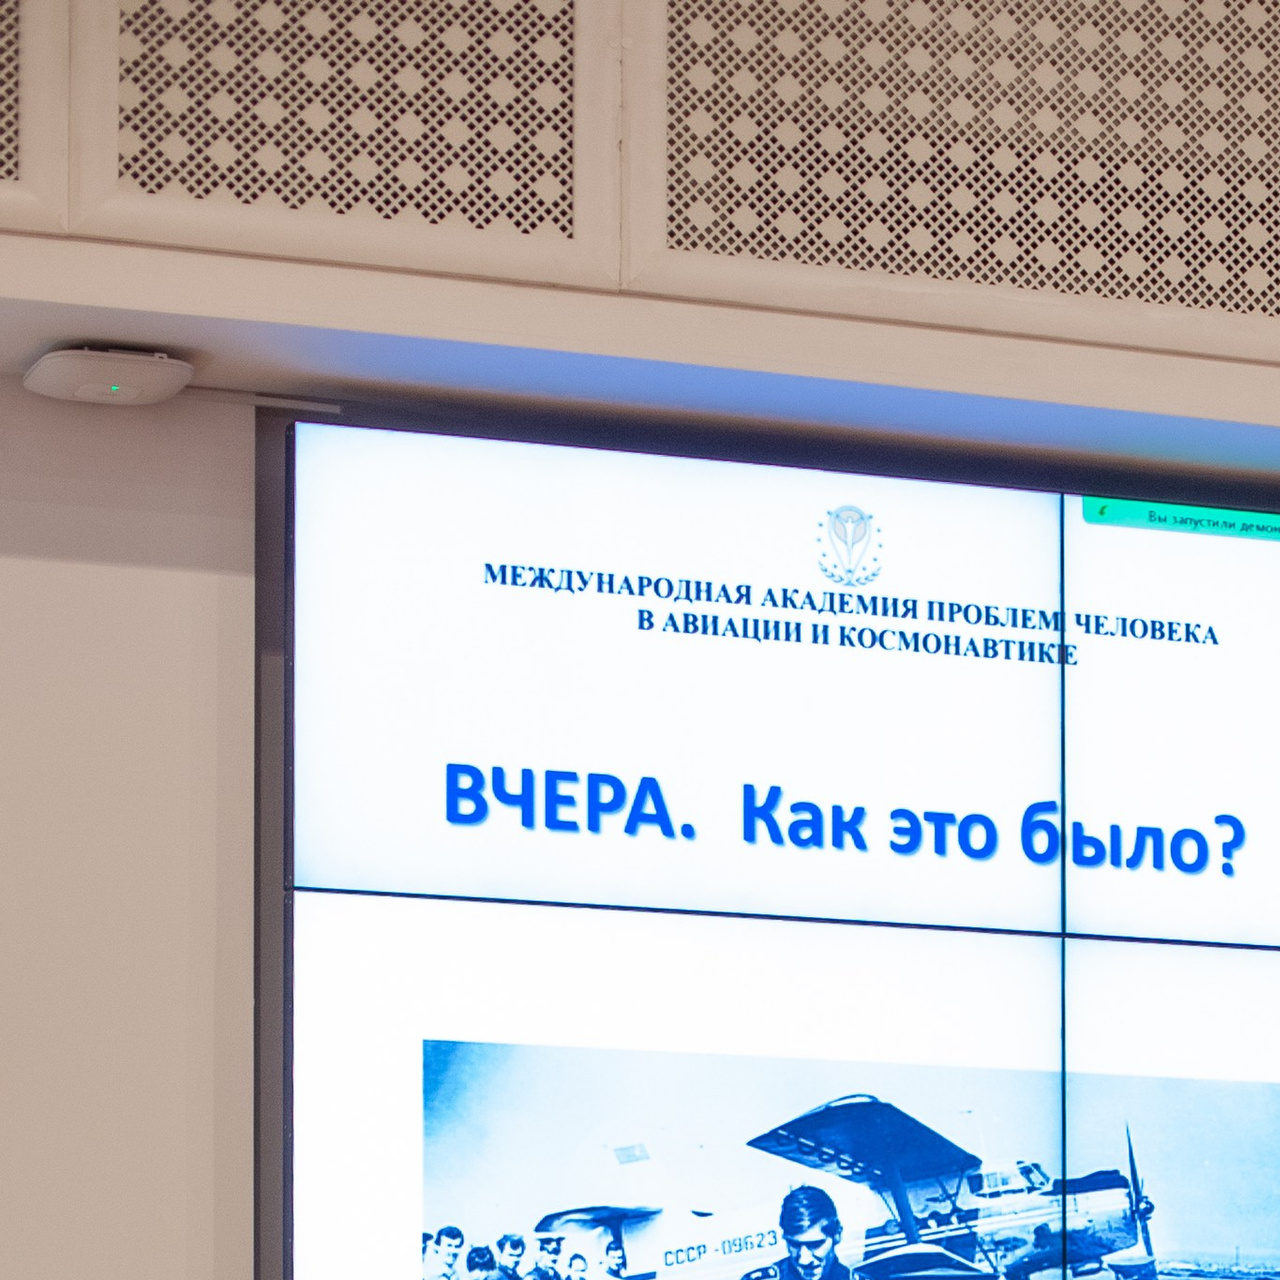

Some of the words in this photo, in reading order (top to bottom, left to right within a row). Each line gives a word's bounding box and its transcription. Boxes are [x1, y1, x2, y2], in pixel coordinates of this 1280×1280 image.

[1147, 510, 1168, 524] Вы
[1172, 514, 1236, 532] запустили
[483, 562, 752, 606] МЕЖДУНАРОДНАЯ
[760, 588, 918, 621] АКАДЕМИЯ
[927, 600, 1066, 633] ПРОБЛЕМ
[1075, 612, 1220, 646] ЧЕЛОВЕКА
[638, 608, 654, 631] В
[662, 613, 803, 644] АВИАЦИИ
[811, 623, 830, 645] И
[839, 625, 1078, 667] КОСМОНАВТИКЕ
[444, 764, 696, 842] ВЧЕРА.
[742, 784, 868, 854] Как
[888, 808, 998, 858] это
[1020, 800, 1248, 878] было?
